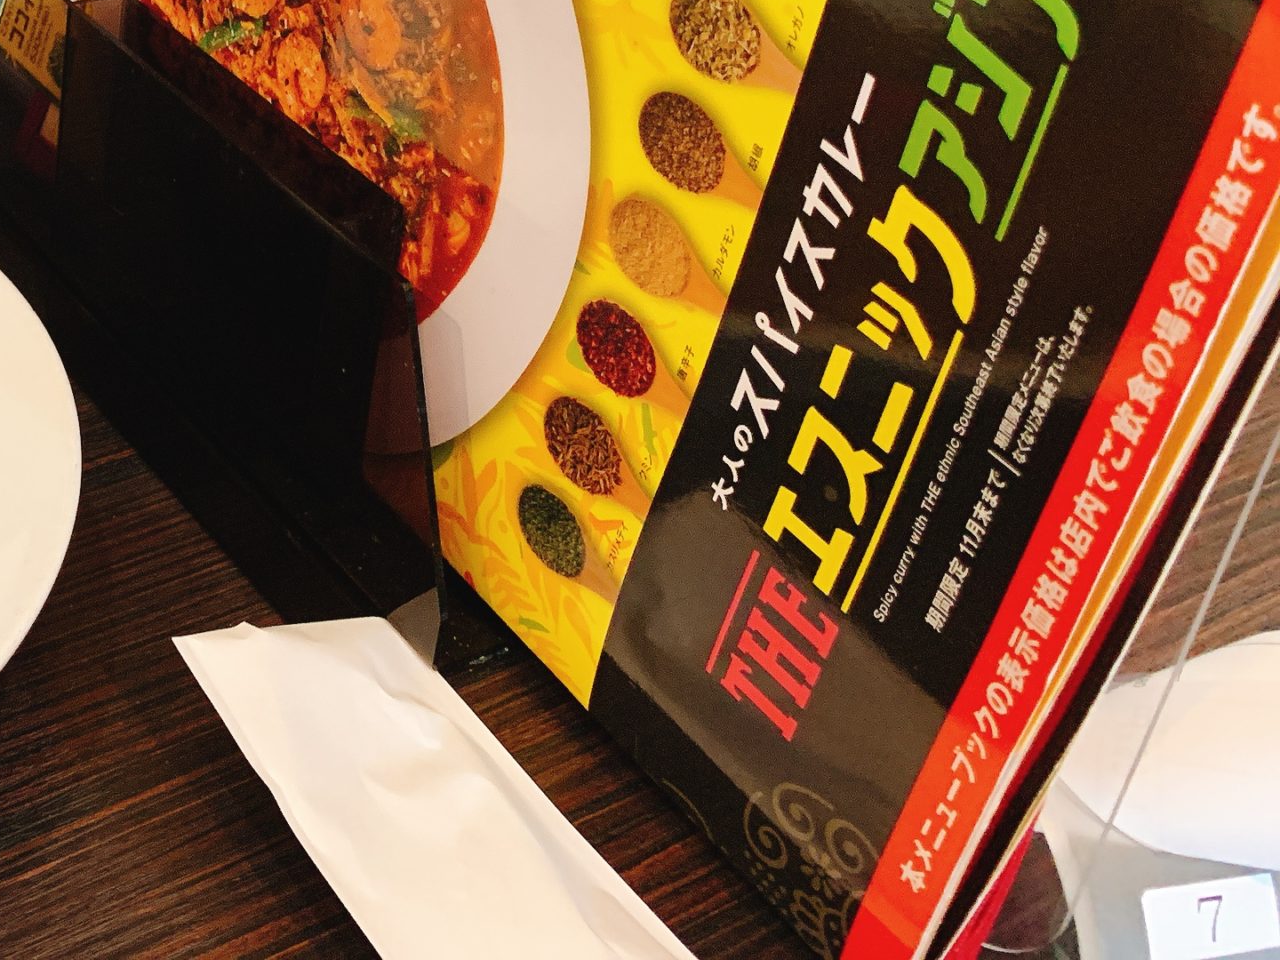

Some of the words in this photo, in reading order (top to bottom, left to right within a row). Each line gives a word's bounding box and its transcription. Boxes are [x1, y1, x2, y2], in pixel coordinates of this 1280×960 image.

[786, 5, 806, 52] オレガノ
[713, 223, 737, 280] カルダモン
[713, 72, 877, 511] 大人のスパイスカレー
[638, 454, 655, 481] クミン
[871, 582, 898, 624] Spicy
[887, 543, 915, 584] curry
[904, 512, 927, 544] with
[918, 481, 940, 512] THE
[931, 435, 960, 483] ethnic
[951, 360, 992, 436] Southeast
[983, 316, 1011, 361] Asian
[1002, 275, 1030, 318] style
[1020, 226, 1049, 275] flavor
[900, 104, 1280, 892] 本メニューブックの表示価格は店内でご飲食の場合の価格です。
[923, 559, 969, 632] 期間限定
[957, 469, 1009, 559] 11月末まで
[721, 573, 840, 742] THE
[1197, 895, 1223, 942] 7
